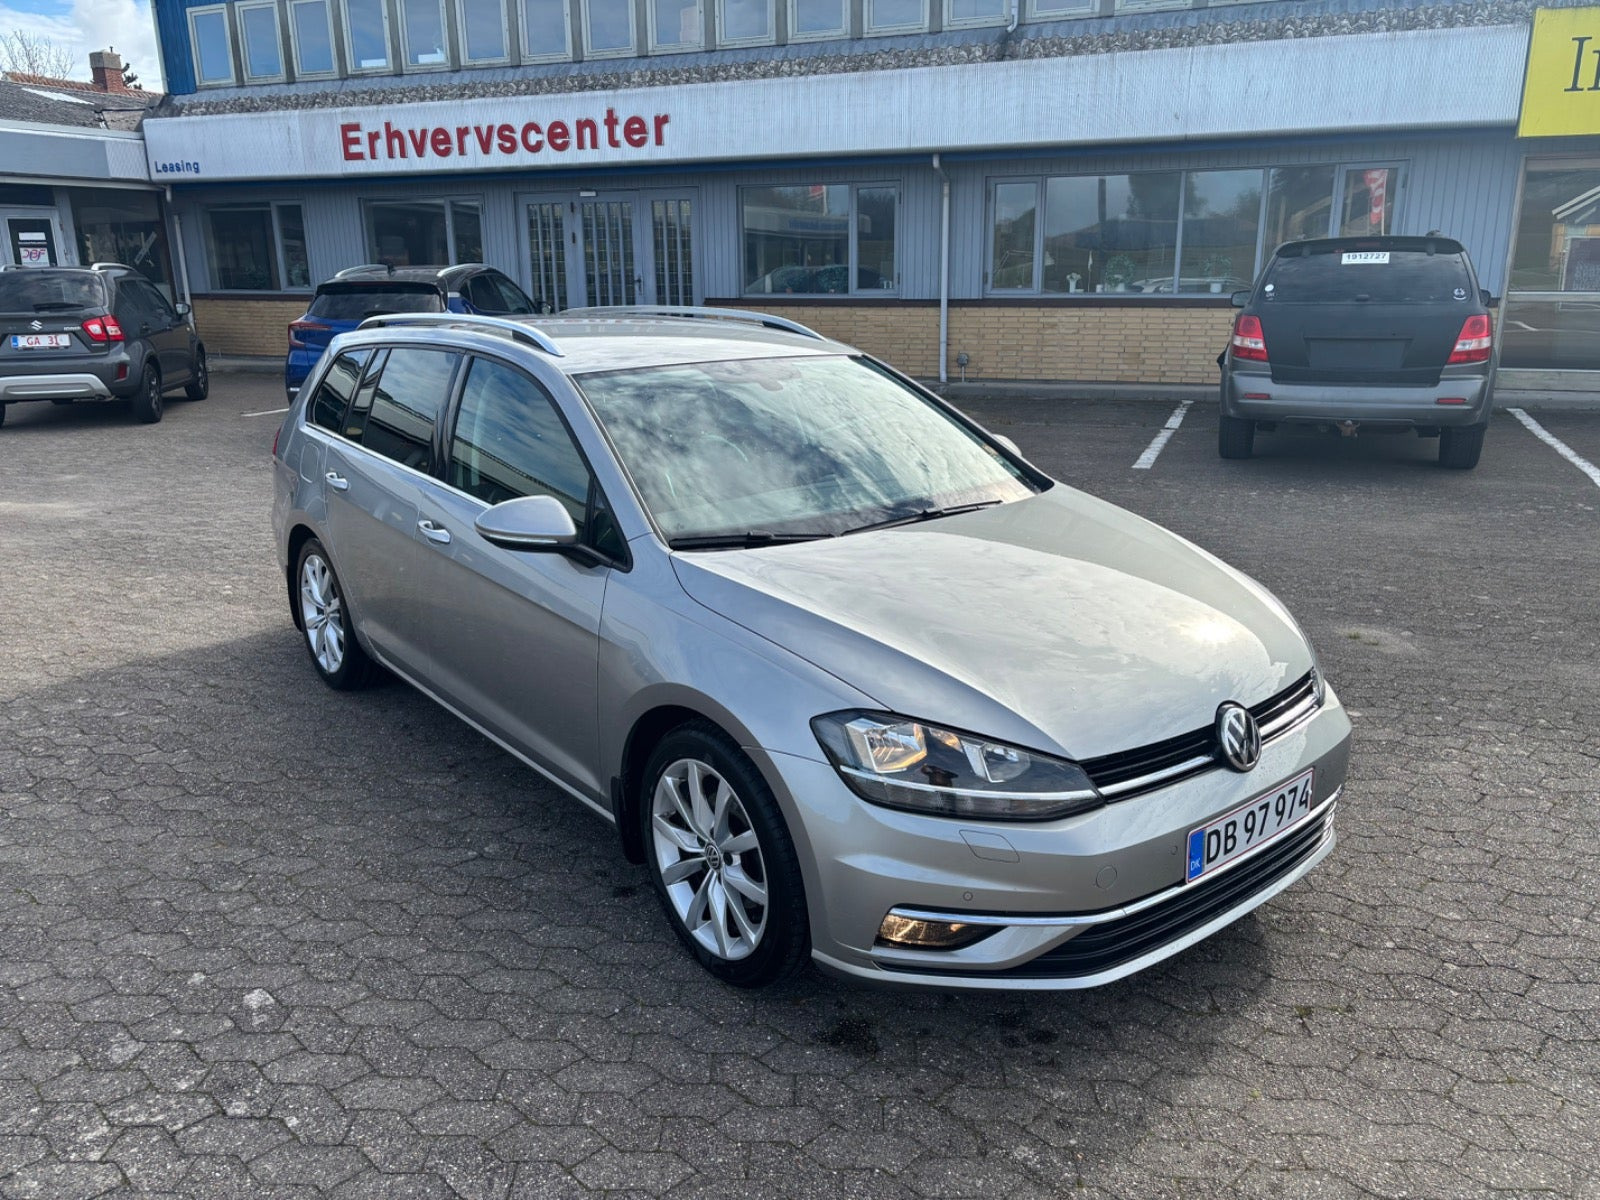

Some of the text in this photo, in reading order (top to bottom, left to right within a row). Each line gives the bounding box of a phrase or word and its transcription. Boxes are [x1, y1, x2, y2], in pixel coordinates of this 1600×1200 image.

[340, 107, 670, 161] Erhvervscenter
[154, 159, 200, 174] Leasing
[26, 336, 41, 346] GA
[1206, 778, 1312, 865] DB 97 974
[1190, 857, 1201, 871] DK
